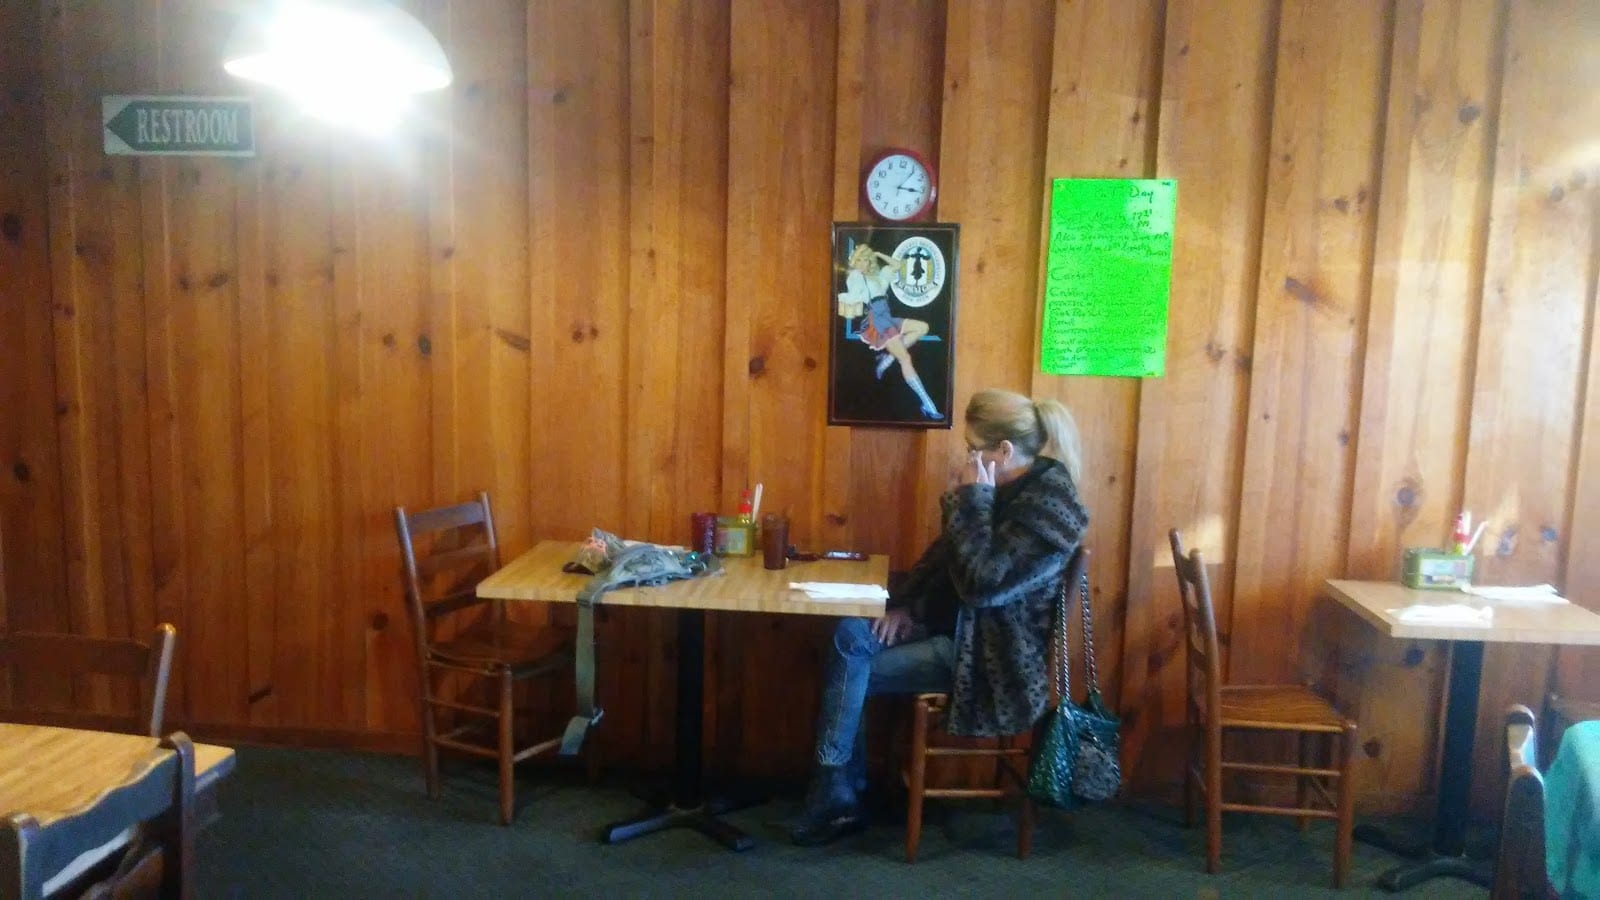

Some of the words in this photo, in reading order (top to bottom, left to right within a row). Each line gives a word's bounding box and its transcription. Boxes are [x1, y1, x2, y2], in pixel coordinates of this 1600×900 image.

[136, 108, 240, 144] RESTROOM
[899, 160, 908, 169] 12
[878, 170, 887, 178] 10
[873, 180, 880, 188] 9
[1128, 184, 1154, 204] Day
[892, 206, 899, 214] 6
